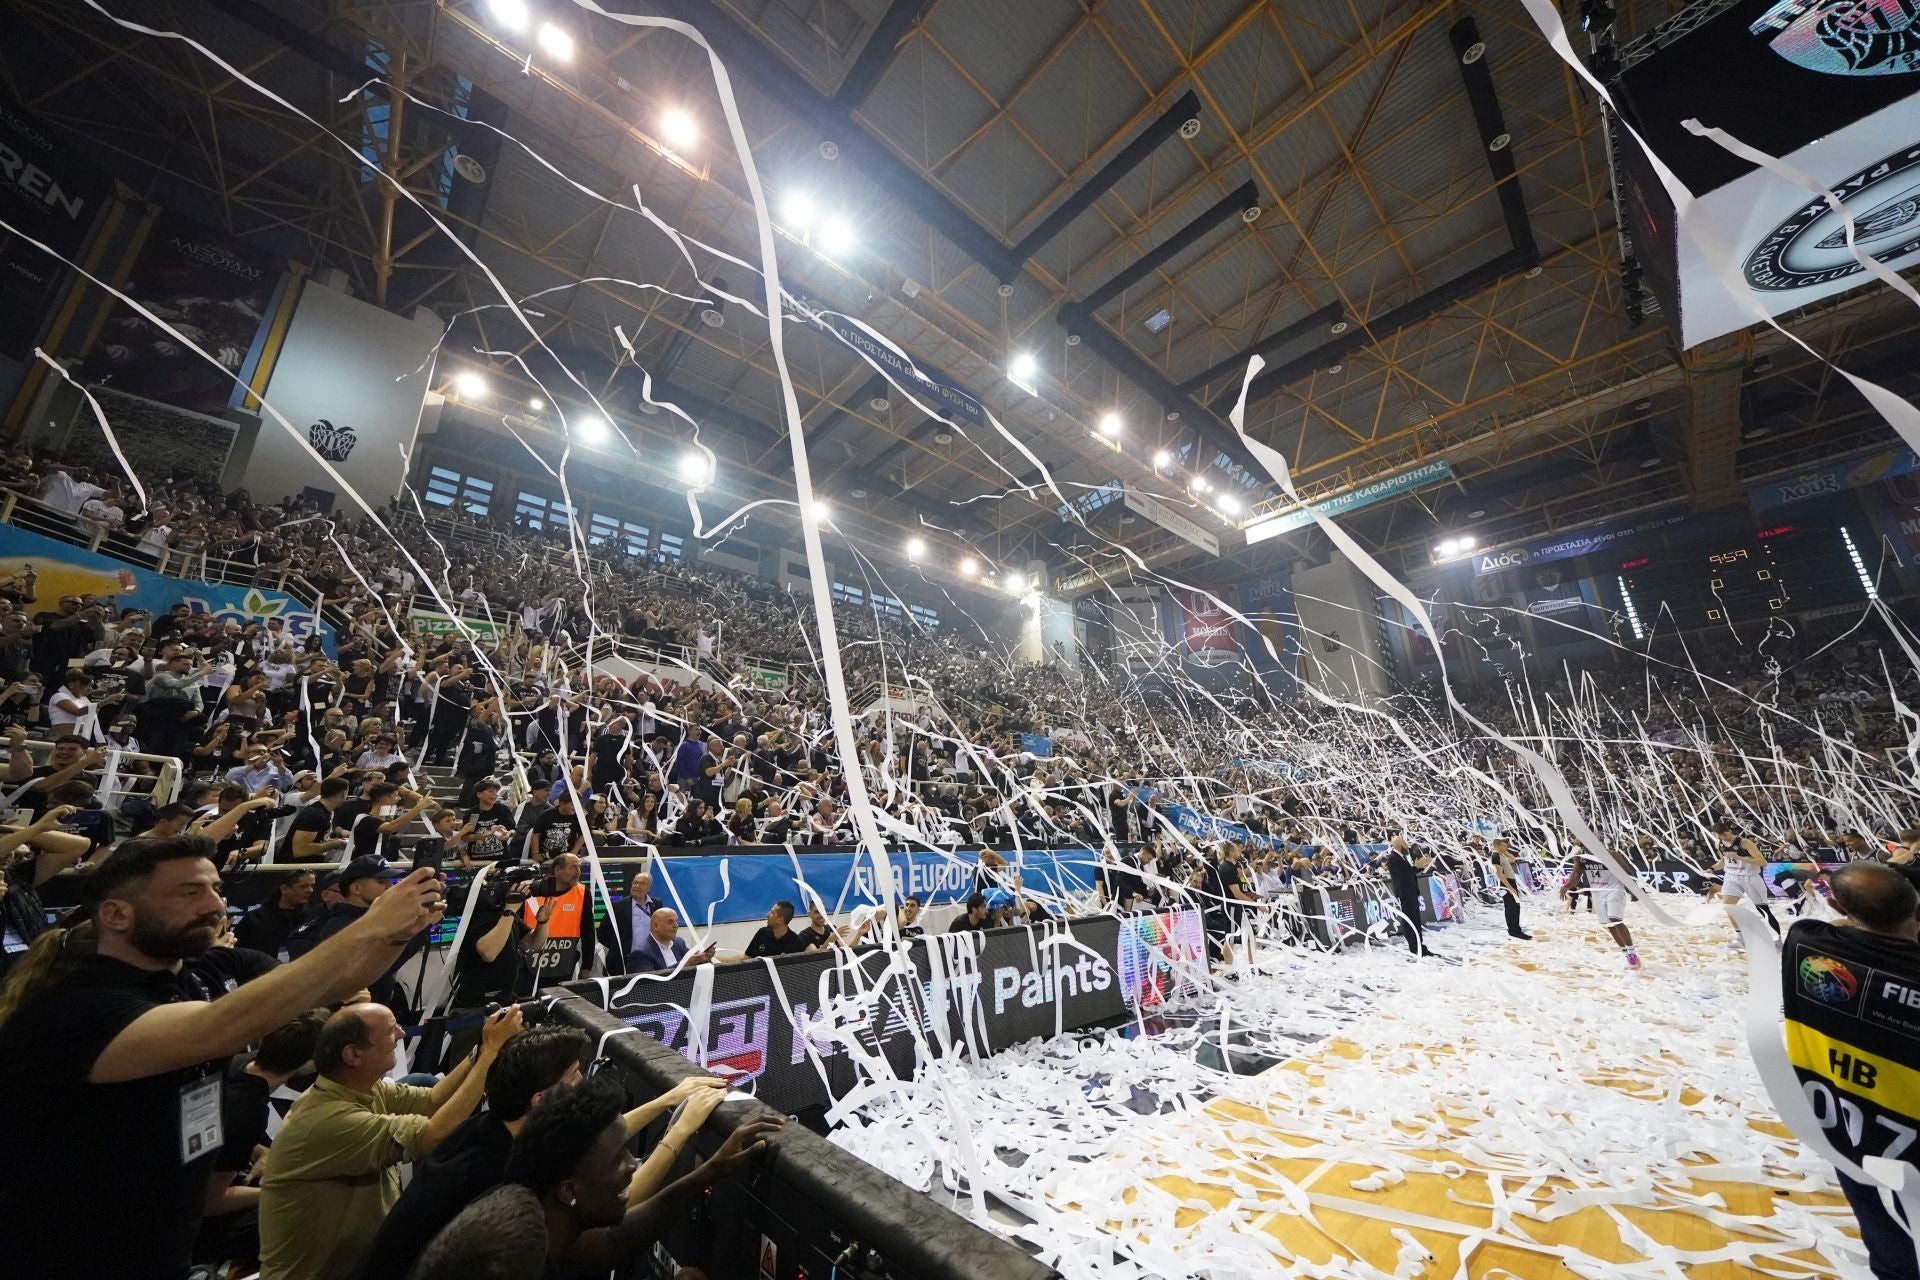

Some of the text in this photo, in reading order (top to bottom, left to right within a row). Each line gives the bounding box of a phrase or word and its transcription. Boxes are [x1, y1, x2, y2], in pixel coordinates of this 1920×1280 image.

[1751, 223, 1799, 287] BASKETBALL
[850, 331, 902, 371] ΠΡΟΣΤΑΣΙΑ
[1355, 460, 1446, 501] ΚΑΘΑΡΙΟΤΗΤΑΣ
[1480, 552, 1523, 571] Διός
[1541, 537, 1592, 555] ΠΡΟΣΤΑΣΙΑ
[1709, 549, 1748, 564] 9:59
[531, 952, 561, 968] 169
[994, 954, 1112, 1015] Paints
[1828, 1047, 1878, 1090] HB
